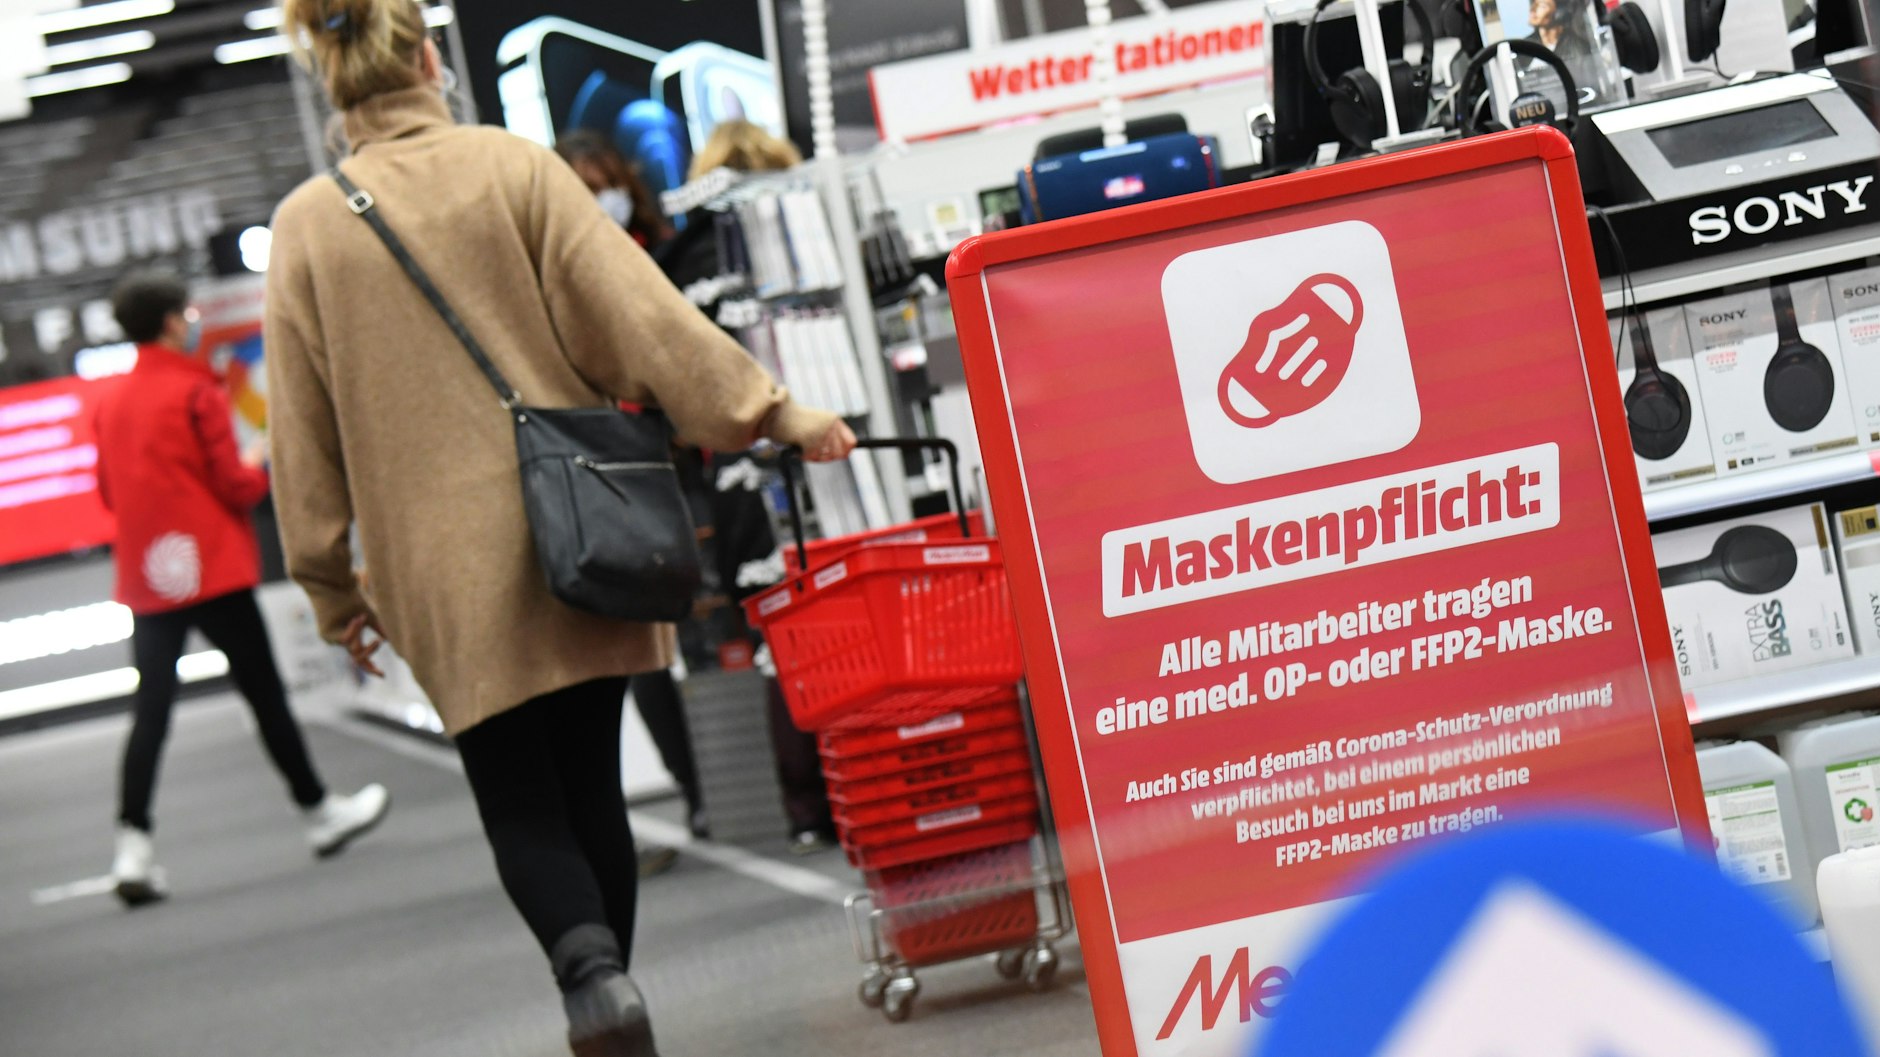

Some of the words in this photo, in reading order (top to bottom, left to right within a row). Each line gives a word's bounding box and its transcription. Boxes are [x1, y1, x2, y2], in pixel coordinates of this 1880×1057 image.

[969, 20, 1264, 102] Wettertationen
[1515, 101, 1546, 120] NEU
[1688, 175, 1874, 246] SONY
[1699, 309, 1746, 327] SONY
[1843, 283, 1880, 299] SON
[1121, 464, 1541, 598] Maskenpflicht:
[1158, 635, 1222, 678] Alle
[1227, 598, 1417, 664] Mitarbeiter
[1422, 575, 1533, 623] tragen
[1744, 602, 1772, 663] EXTRA
[1762, 597, 1793, 659] BASS
[1869, 591, 1880, 640] ONY
[1095, 696, 1169, 736] eine
[1175, 671, 1258, 720] med.
[1263, 662, 1322, 701] OP-
[1327, 646, 1405, 688] oder
[1410, 604, 1613, 672] FFP2-Maske.
[1672, 625, 1692, 677] SONY
[1126, 772, 1177, 803] Auch
[1180, 767, 1210, 792] Sie
[1213, 755, 1257, 785] sind
[1260, 740, 1333, 779] gemäß
[1336, 682, 1613, 760] Corona-Schutz-Verordnung
[1191, 770, 1321, 821] verpflichtet,
[1324, 763, 1357, 793] bei
[1360, 754, 1425, 785] einem
[1428, 725, 1561, 775] persönlichen
[1236, 807, 1309, 844] Besuch
[1312, 799, 1345, 828] bei
[1348, 795, 1386, 821] uns
[1388, 788, 1416, 812] im
[1419, 771, 1482, 806] Markt
[1485, 765, 1530, 792] eine
[1275, 825, 1399, 868] FFP2-Maske
[1401, 819, 1426, 841] zu
[1428, 804, 1504, 836] tragen.
